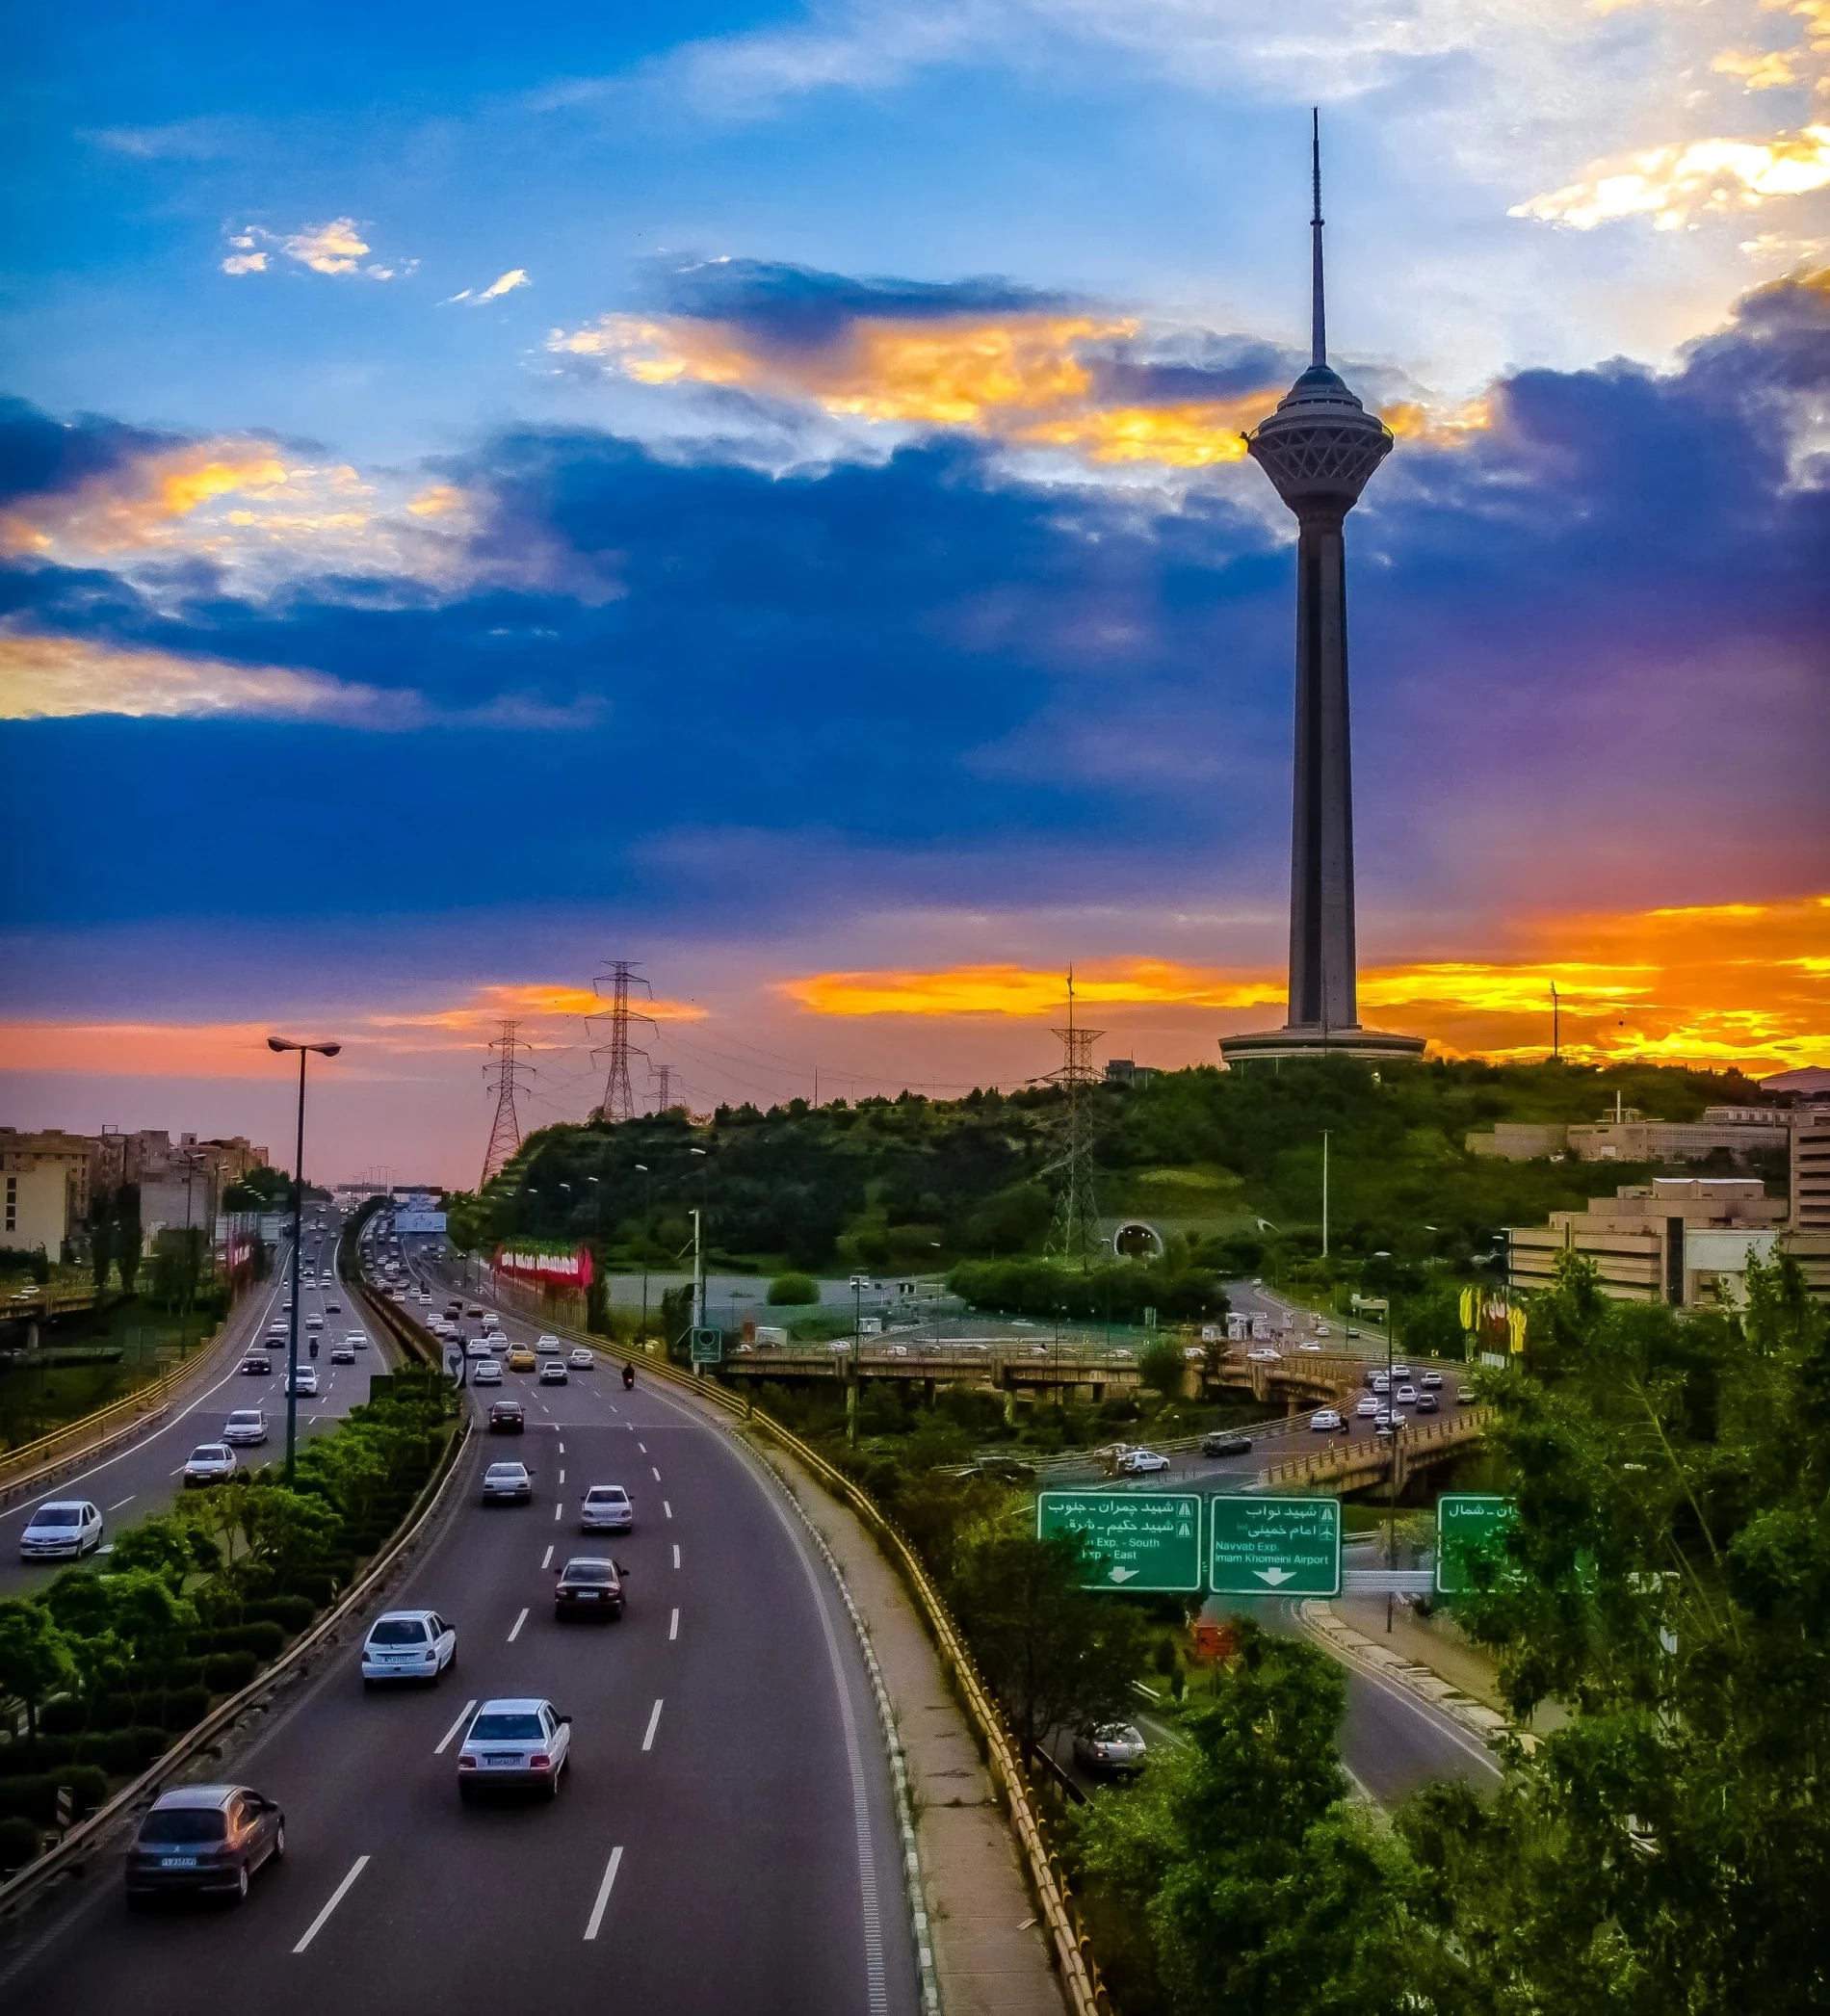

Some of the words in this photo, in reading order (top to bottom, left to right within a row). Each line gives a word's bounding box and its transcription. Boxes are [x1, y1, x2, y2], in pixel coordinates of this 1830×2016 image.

[1048, 1502, 1086, 1516] جنوب
[1098, 1500, 1138, 1517] چمران
[1140, 1500, 1174, 1515] شهید
[1245, 1505, 1281, 1521] نواب
[1284, 1505, 1317, 1519] شهید
[1449, 1504, 1484, 1517] شمال
[1107, 1519, 1137, 1535] حکیم
[1140, 1519, 1174, 1533] شهید
[1247, 1525, 1287, 1538] خمینی
[1289, 1524, 1317, 1540] امام
[1096, 1537, 1118, 1548] Exp.
[1129, 1537, 1160, 1548] South
[1216, 1540, 1255, 1552] Navvab
[1257, 1541, 1280, 1553] Exp.
[1113, 1549, 1137, 1559] East
[1215, 1552, 1242, 1563] Imam
[1244, 1553, 1292, 1564] Khomeini
[1294, 1554, 1329, 1566] Airport
